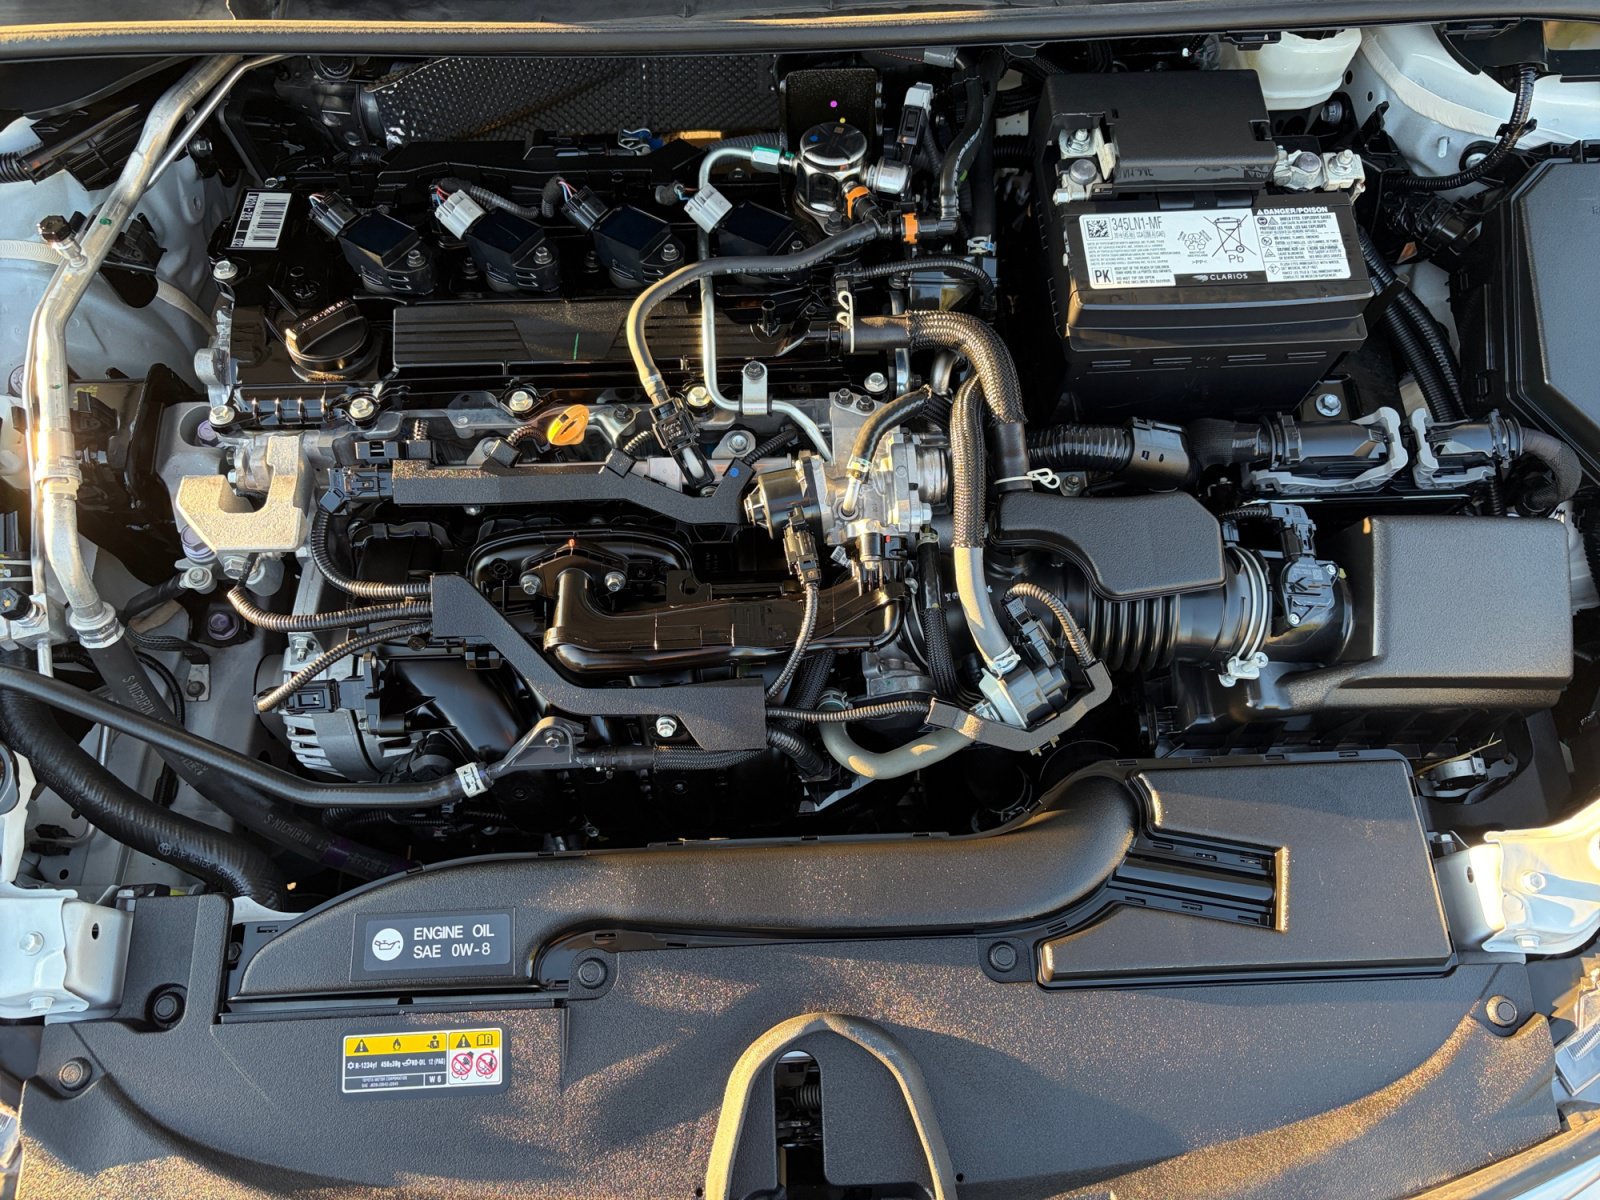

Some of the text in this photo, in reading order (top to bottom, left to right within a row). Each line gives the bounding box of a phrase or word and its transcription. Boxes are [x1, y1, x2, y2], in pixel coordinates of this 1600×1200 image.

[1263, 206, 1328, 215] DANGER/POISON
[1112, 216, 1162, 231] 345LN1-MF
[1228, 254, 1244, 263] Pb
[1094, 269, 1111, 283] PK
[414, 924, 494, 940] ENGINE OIL
[413, 943, 491, 959] SAE 0W-8
